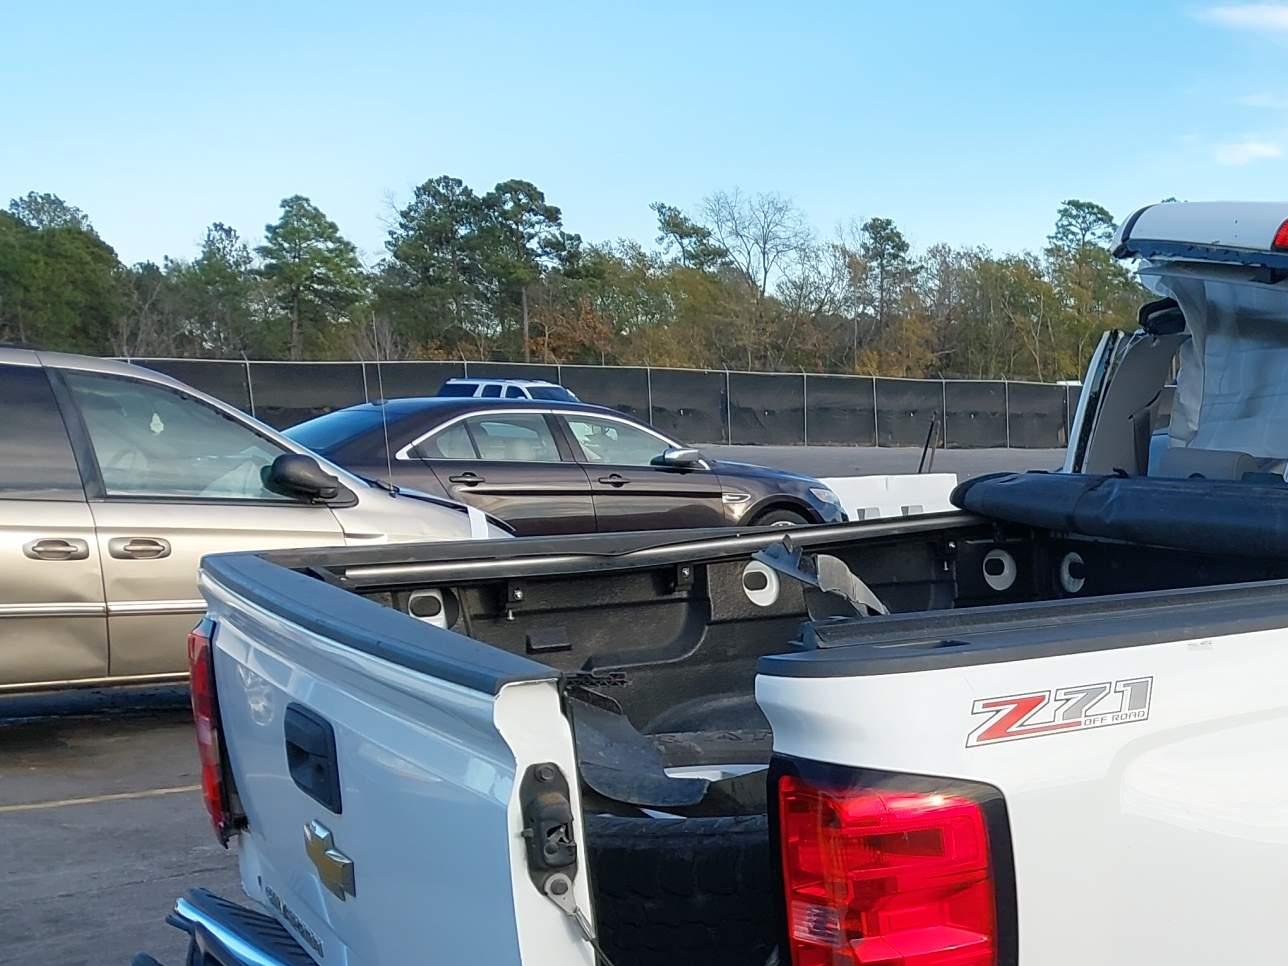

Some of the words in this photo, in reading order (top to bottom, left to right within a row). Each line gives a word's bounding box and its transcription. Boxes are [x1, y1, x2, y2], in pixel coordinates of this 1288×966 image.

[965, 676, 1154, 748] Z71
[1084, 715, 1108, 726] OFF
[1111, 710, 1146, 722] ROAD
